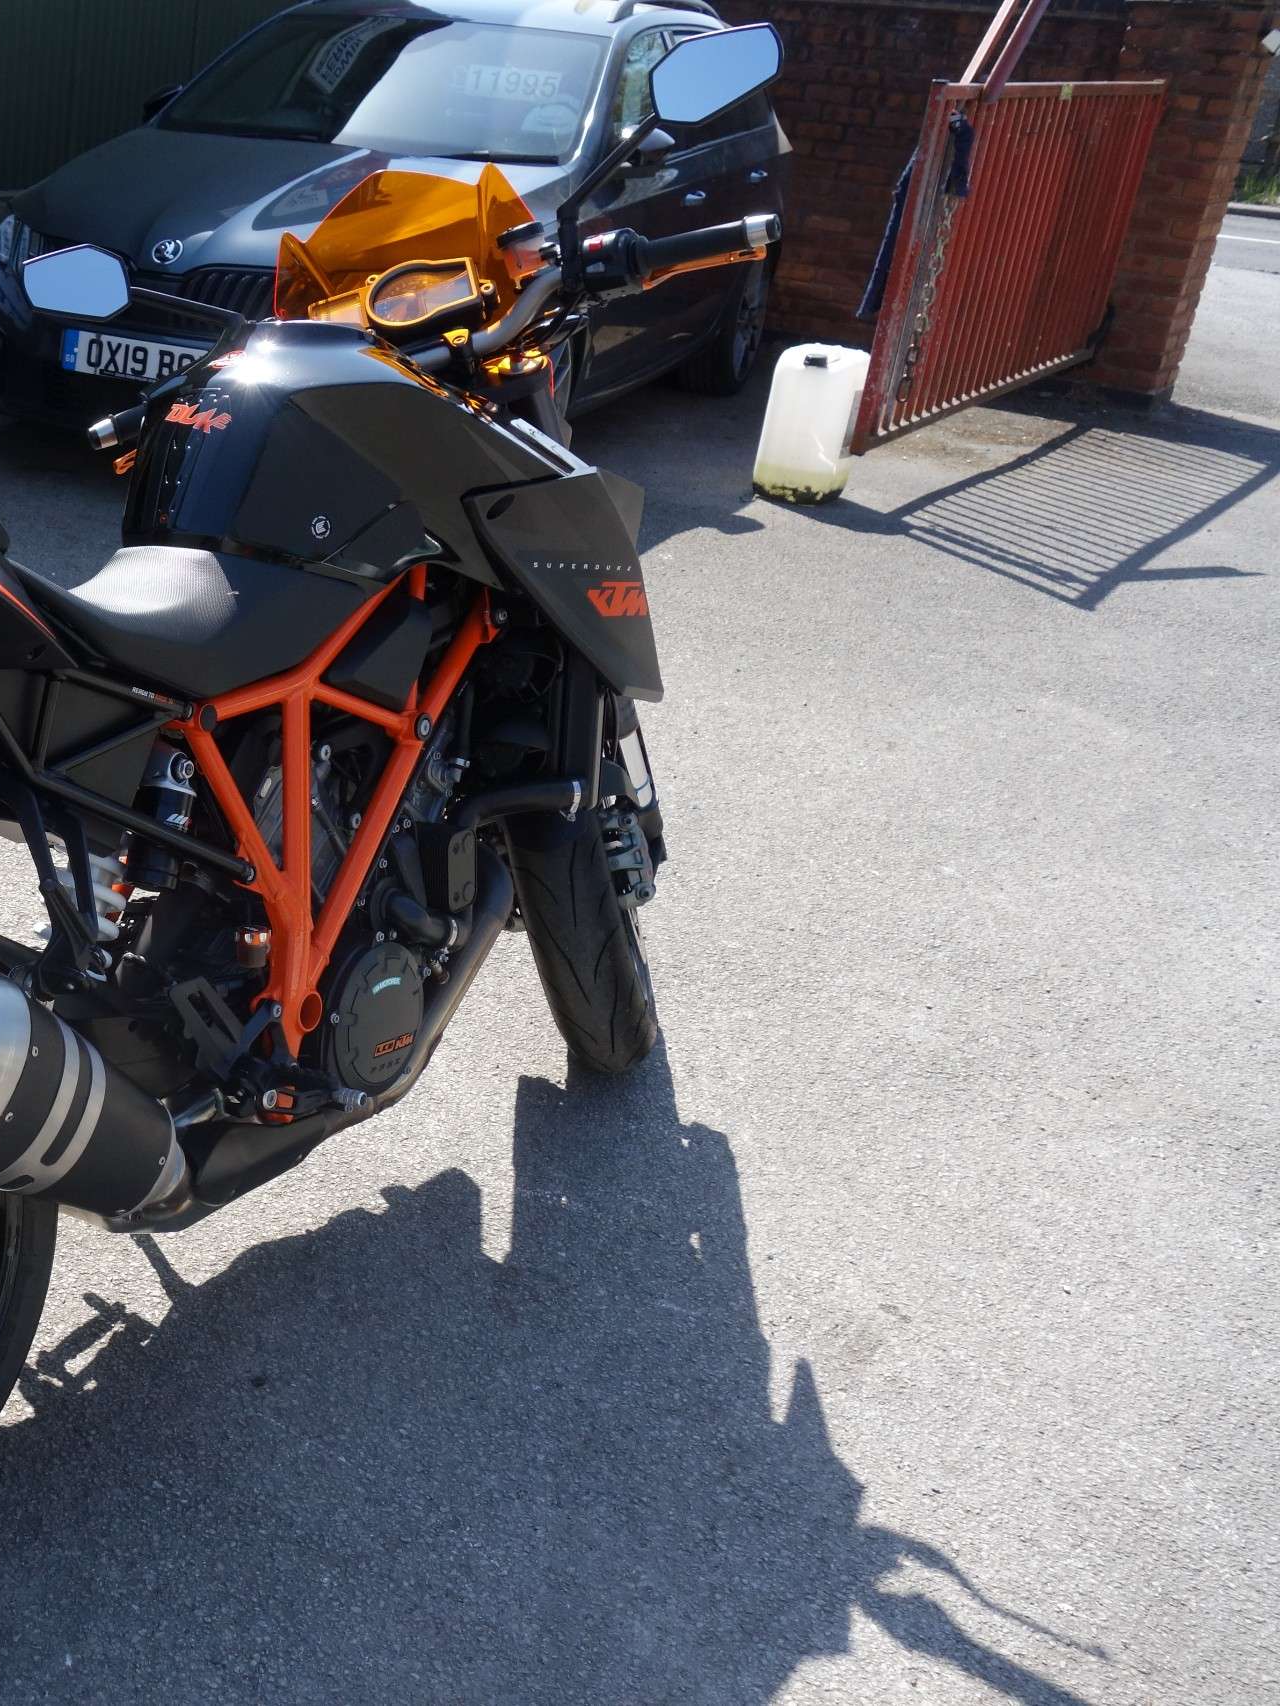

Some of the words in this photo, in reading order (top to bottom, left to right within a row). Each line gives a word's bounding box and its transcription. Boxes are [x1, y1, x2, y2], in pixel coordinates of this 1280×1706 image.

[471, 67, 558, 98] 11995
[86, 338, 149, 376] OX19
[165, 403, 232, 434] DUKE
[587, 581, 649, 617] KTM
